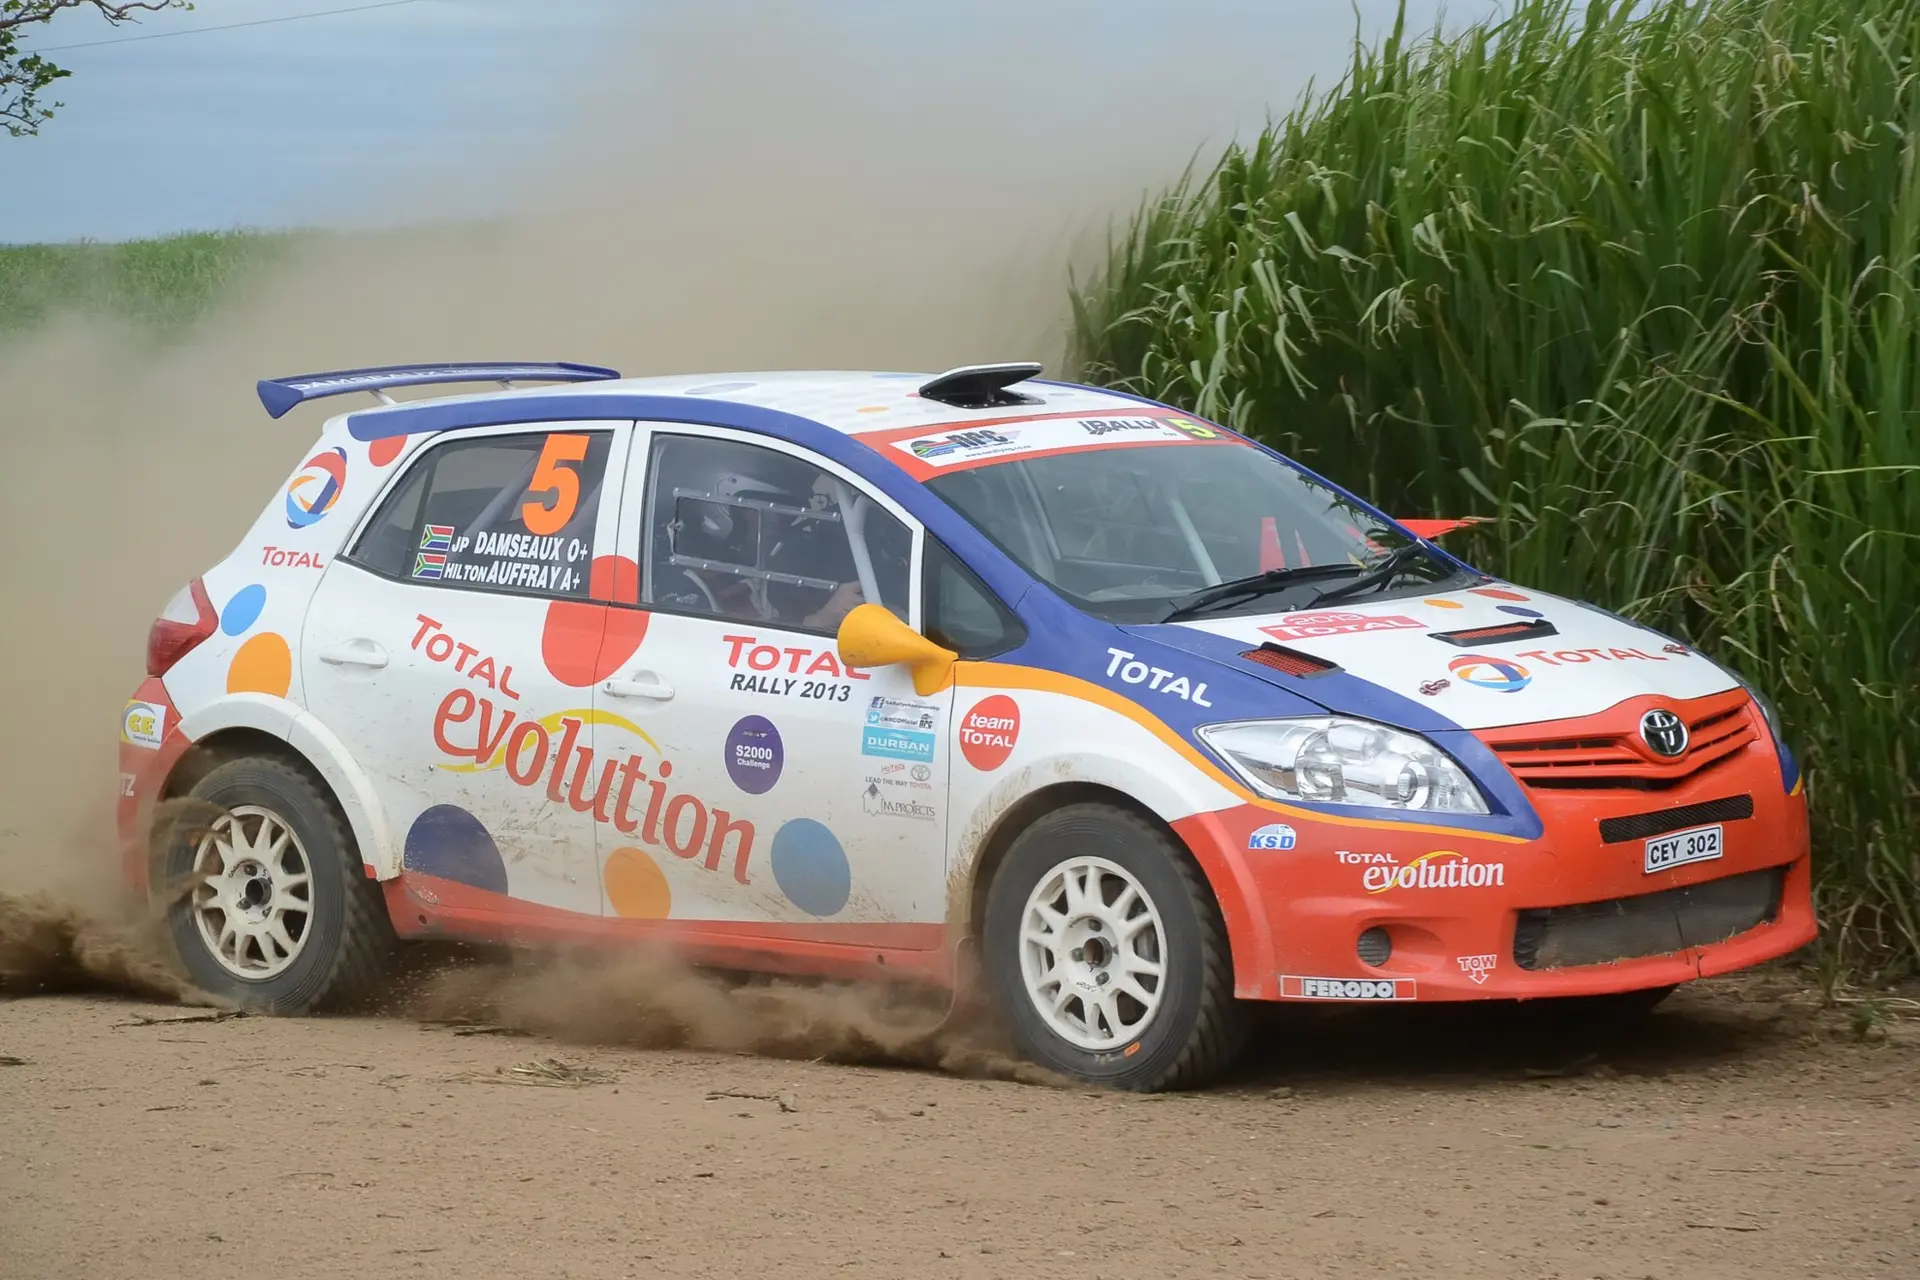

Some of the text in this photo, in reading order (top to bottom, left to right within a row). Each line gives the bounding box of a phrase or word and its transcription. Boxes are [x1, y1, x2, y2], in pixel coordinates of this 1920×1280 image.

[1166, 418, 1216, 438] 5
[522, 434, 590, 535] 5
[451, 536, 469, 552] JP
[474, 531, 564, 561] DAMSEAUX
[262, 546, 324, 569] TOTAL
[443, 560, 581, 591] HILTON AUFFRAY A+
[1267, 619, 1423, 637] TOTAL
[1289, 613, 1363, 625] 2013
[410, 613, 521, 700] TOTAL
[1515, 648, 1669, 666] TOTAL
[1106, 647, 1213, 708] TOTAL
[729, 673, 851, 702] RALLY 2013
[970, 713, 1015, 731] team
[867, 736, 930, 752] DURBAN
[962, 728, 1014, 748] TOTAL
[735, 744, 773, 760] S2000
[737, 758, 771, 770] Challenge
[433, 688, 757, 886] evolution
[865, 776, 881, 784] LEAD
[909, 781, 932, 790] TOYOTA
[1249, 835, 1294, 848] KSD
[1650, 833, 1717, 864] CEY 302
[1335, 851, 1399, 864] TOTAL
[1363, 857, 1505, 891] evolution
[1459, 956, 1496, 970] TOW
[1304, 980, 1394, 997] FERODO
